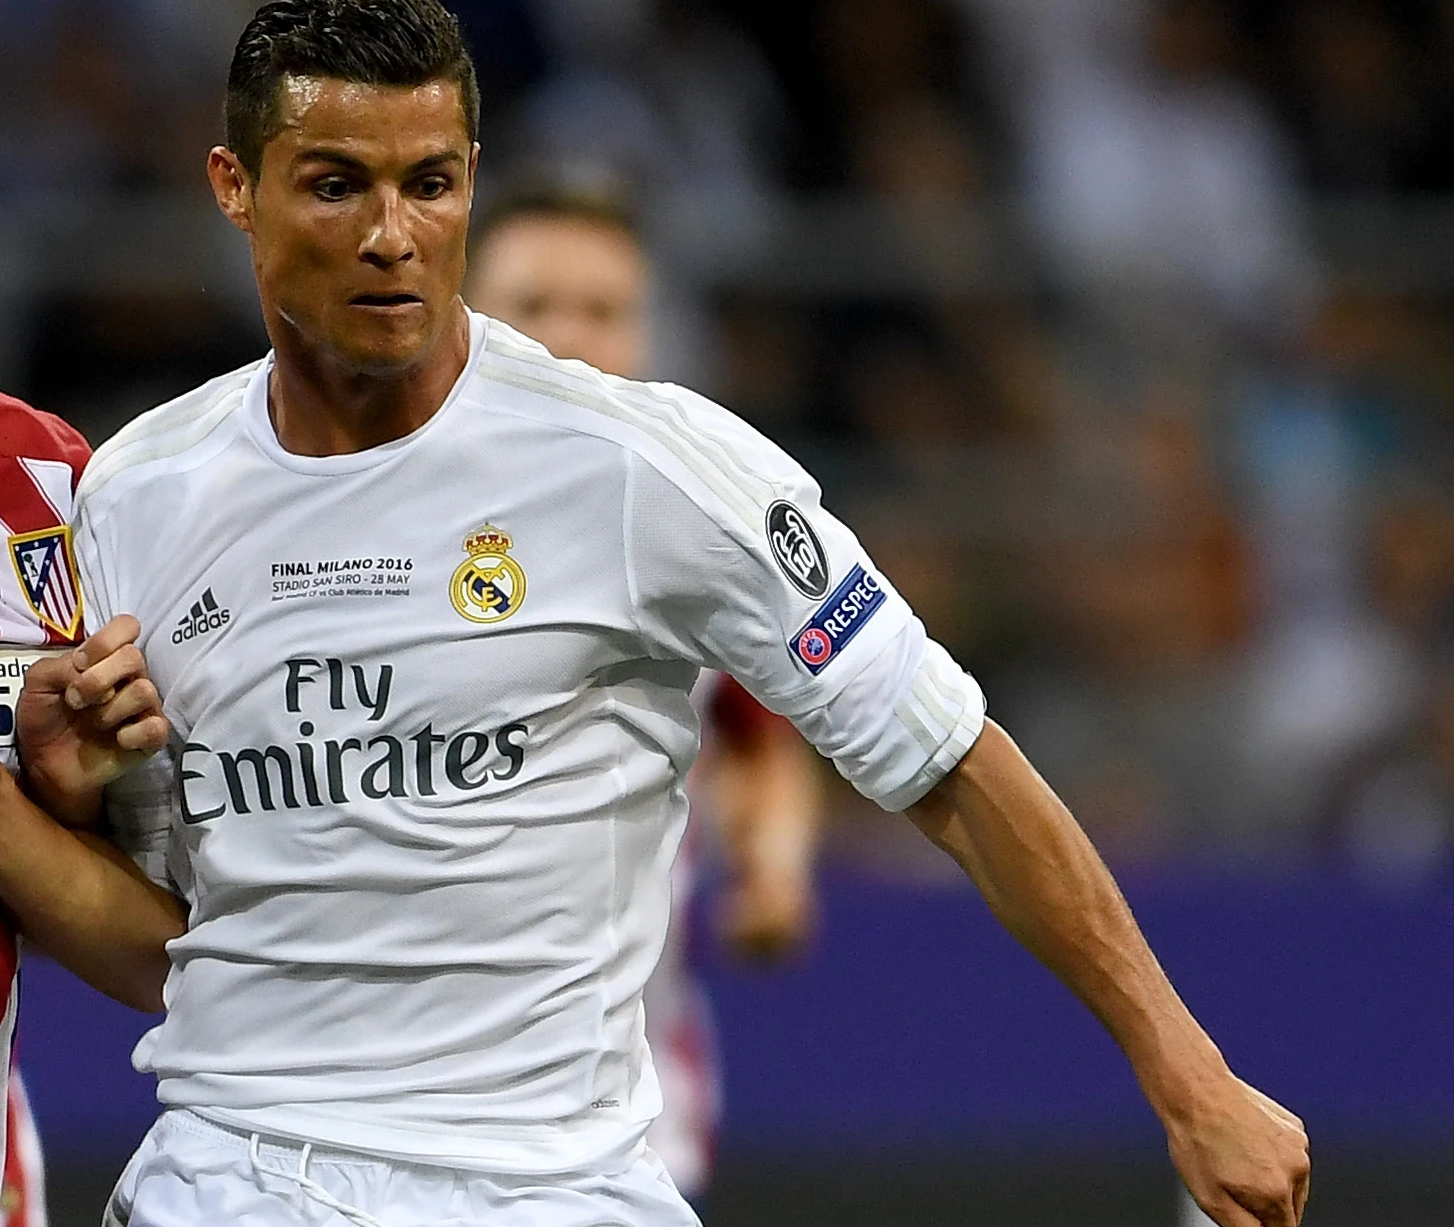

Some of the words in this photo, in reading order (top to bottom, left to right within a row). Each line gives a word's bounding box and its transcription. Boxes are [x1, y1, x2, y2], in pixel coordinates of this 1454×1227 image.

[271, 562, 313, 577] FINAL
[317, 559, 373, 574] MILANO
[376, 558, 413, 570] 2016
[794, 542, 815, 578] 10
[273, 580, 310, 592] STADIO
[312, 576, 333, 587] SAN
[335, 574, 361, 585] SIRO
[371, 574, 384, 584] 28
[387, 574, 410, 584] MAY
[328, 588, 344, 597] Club
[374, 588, 383, 596] de
[385, 588, 410, 597] Madrid
[823, 572, 880, 639] RESPEC
[172, 609, 230, 645] adidas
[285, 658, 393, 721] Fly
[179, 721, 529, 825] Emirates
